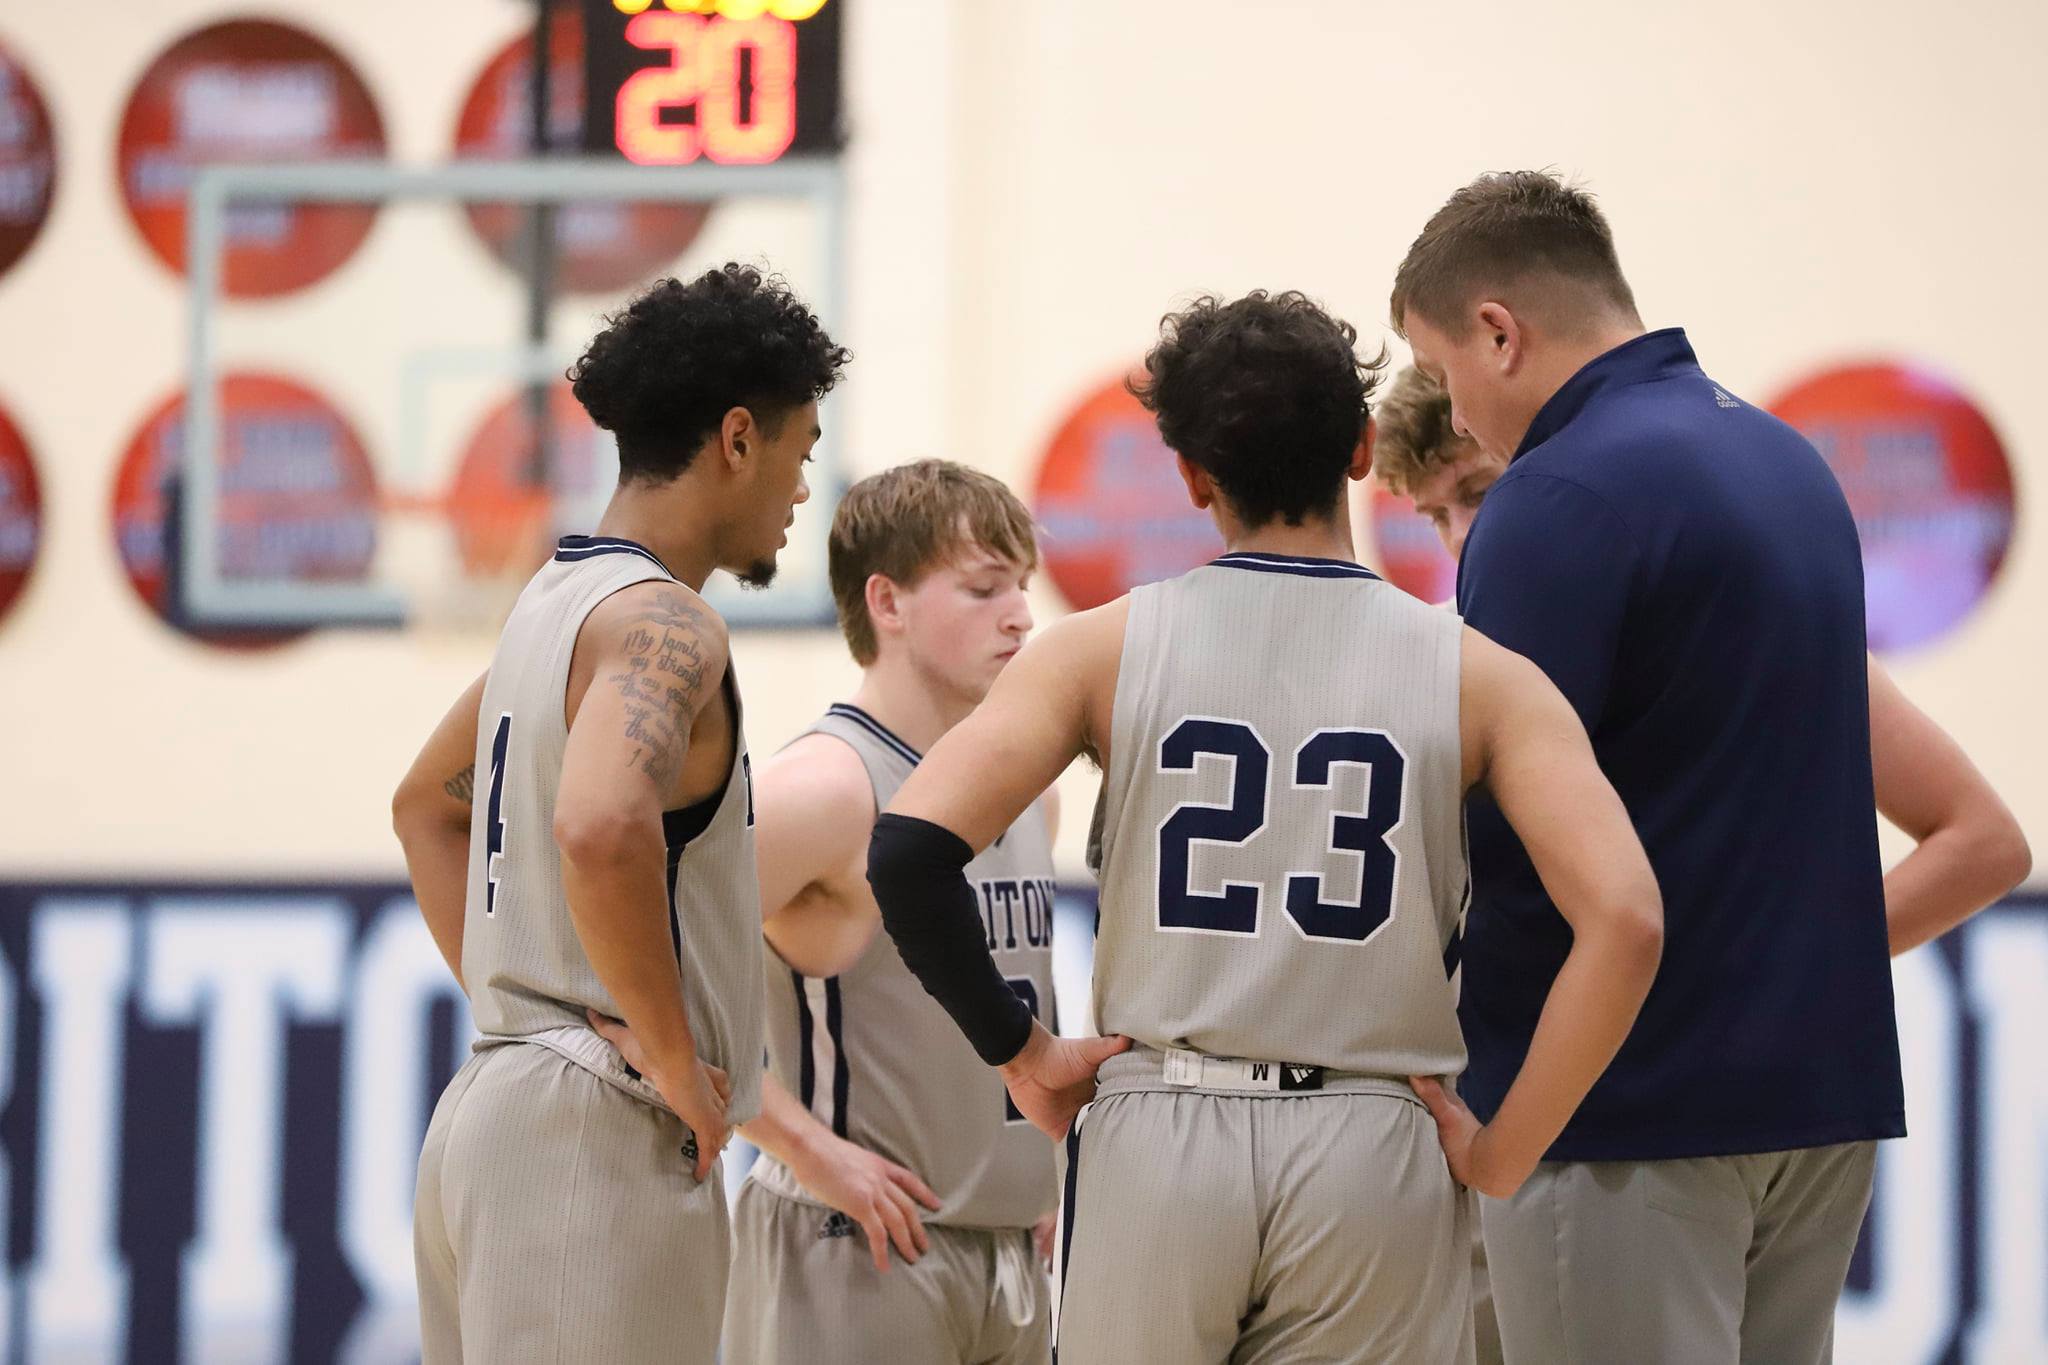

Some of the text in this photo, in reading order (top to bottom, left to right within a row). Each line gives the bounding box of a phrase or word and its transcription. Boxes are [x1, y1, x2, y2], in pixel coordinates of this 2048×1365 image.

[615, 10, 797, 166] 20
[652, 626, 703, 669] family
[1155, 714, 1409, 946] 23
